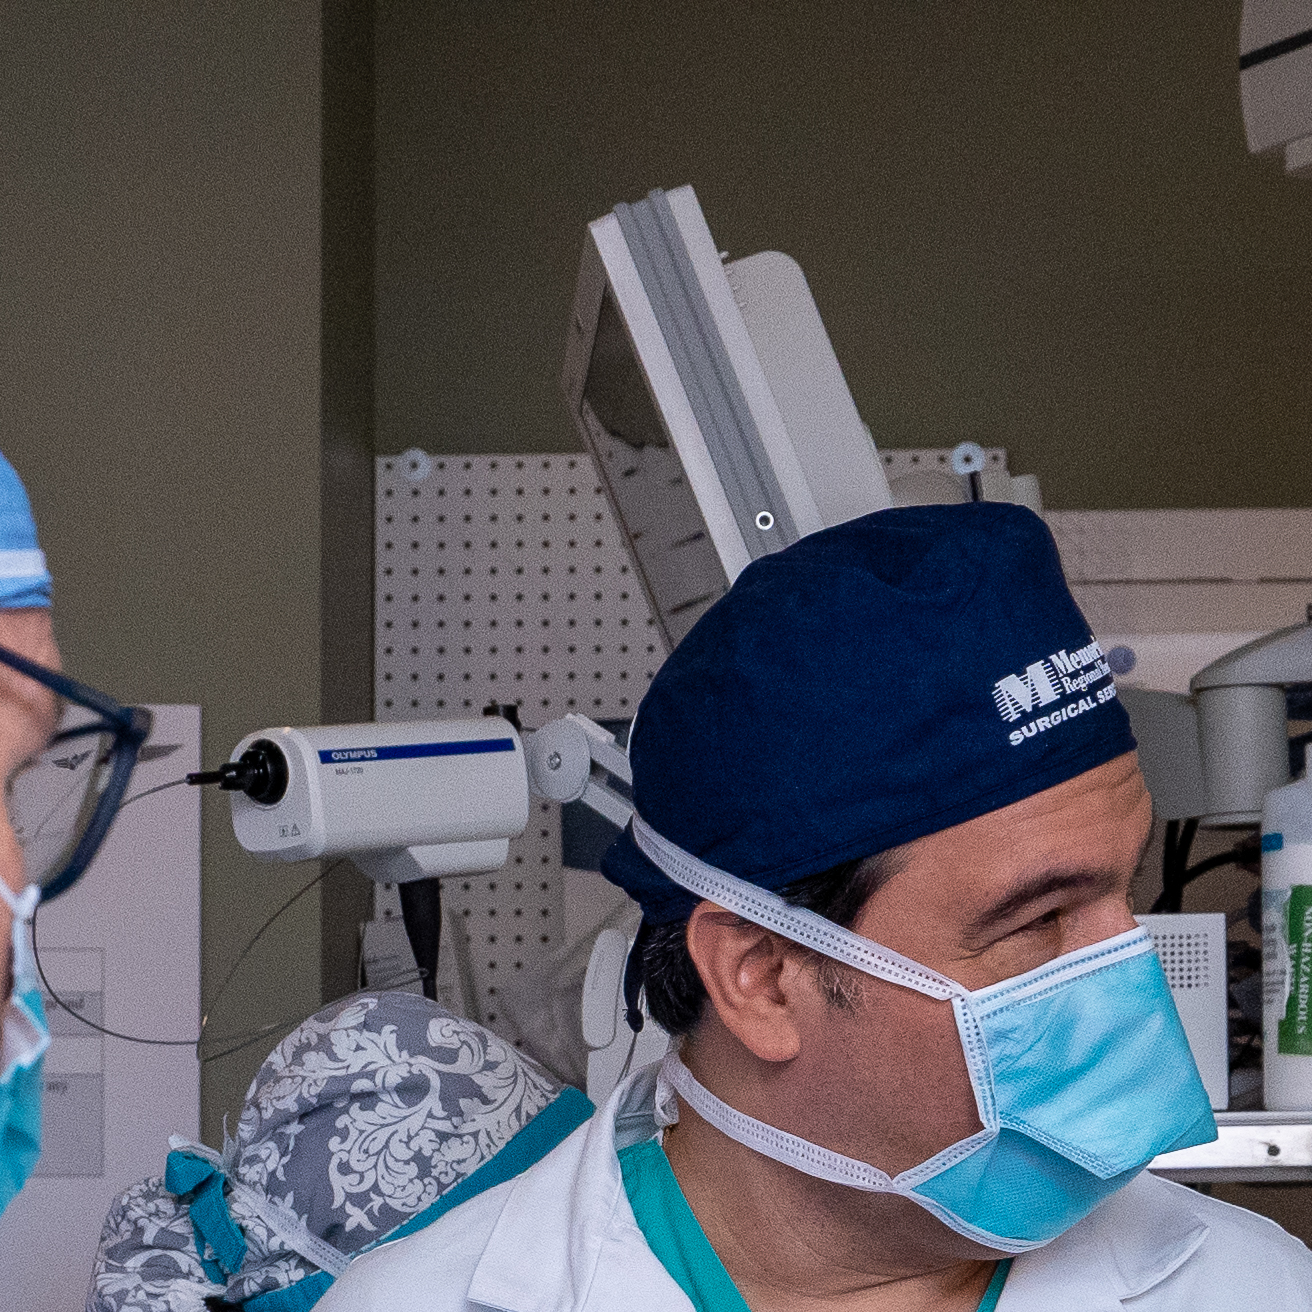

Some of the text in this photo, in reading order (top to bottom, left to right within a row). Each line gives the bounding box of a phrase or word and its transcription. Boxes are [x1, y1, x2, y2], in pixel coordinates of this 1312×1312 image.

[1008, 682, 1117, 746] SURGICAL SER
[331, 749, 378, 760] OLYMPUS
